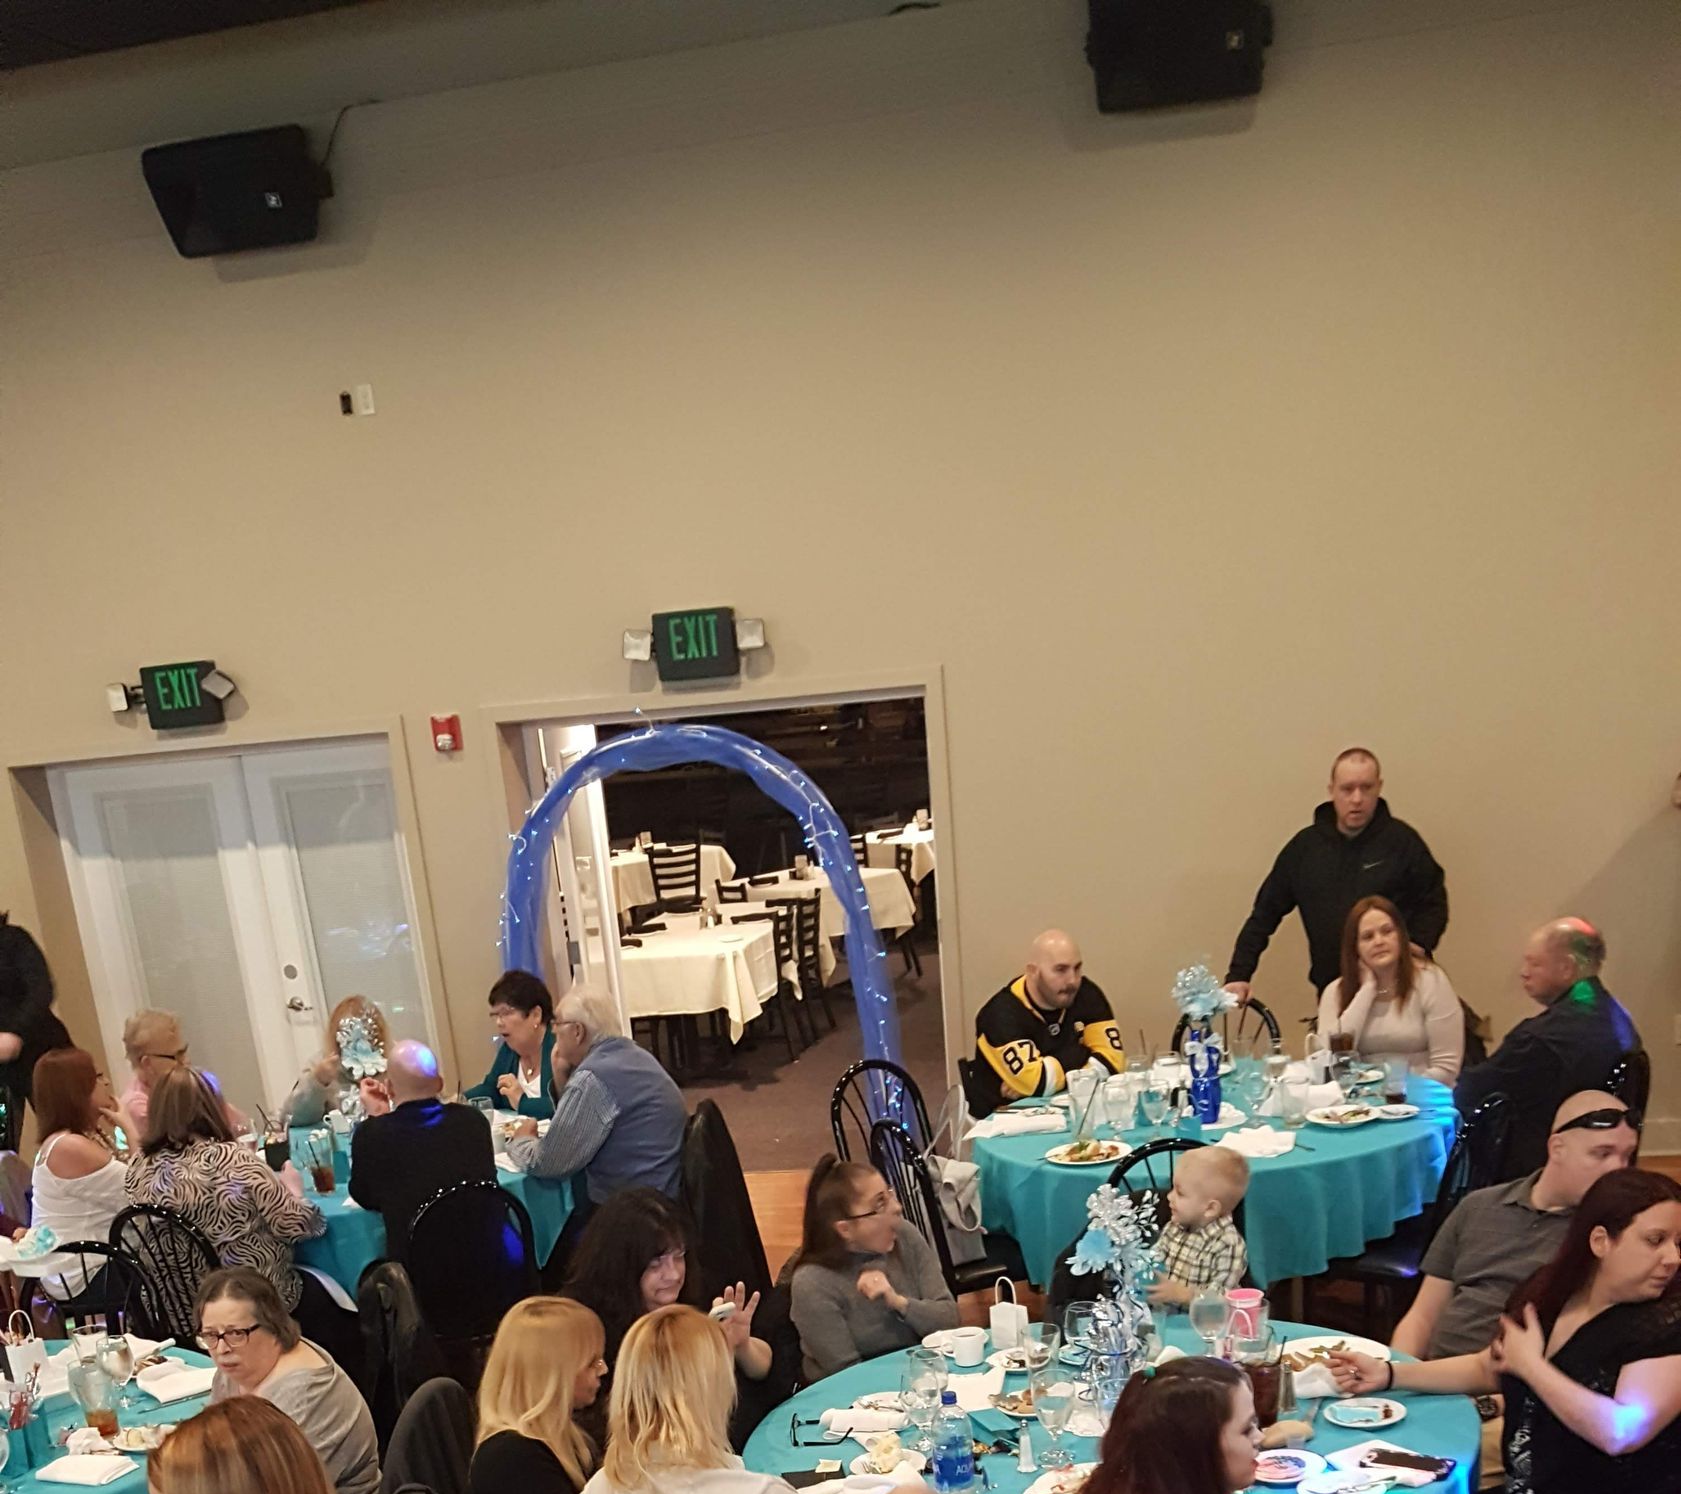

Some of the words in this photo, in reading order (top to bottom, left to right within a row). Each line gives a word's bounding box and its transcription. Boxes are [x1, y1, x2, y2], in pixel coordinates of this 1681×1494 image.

[667, 613, 718, 661] EXIT
[154, 667, 201, 710] EXIT
[1003, 1040, 1037, 1076] 87
